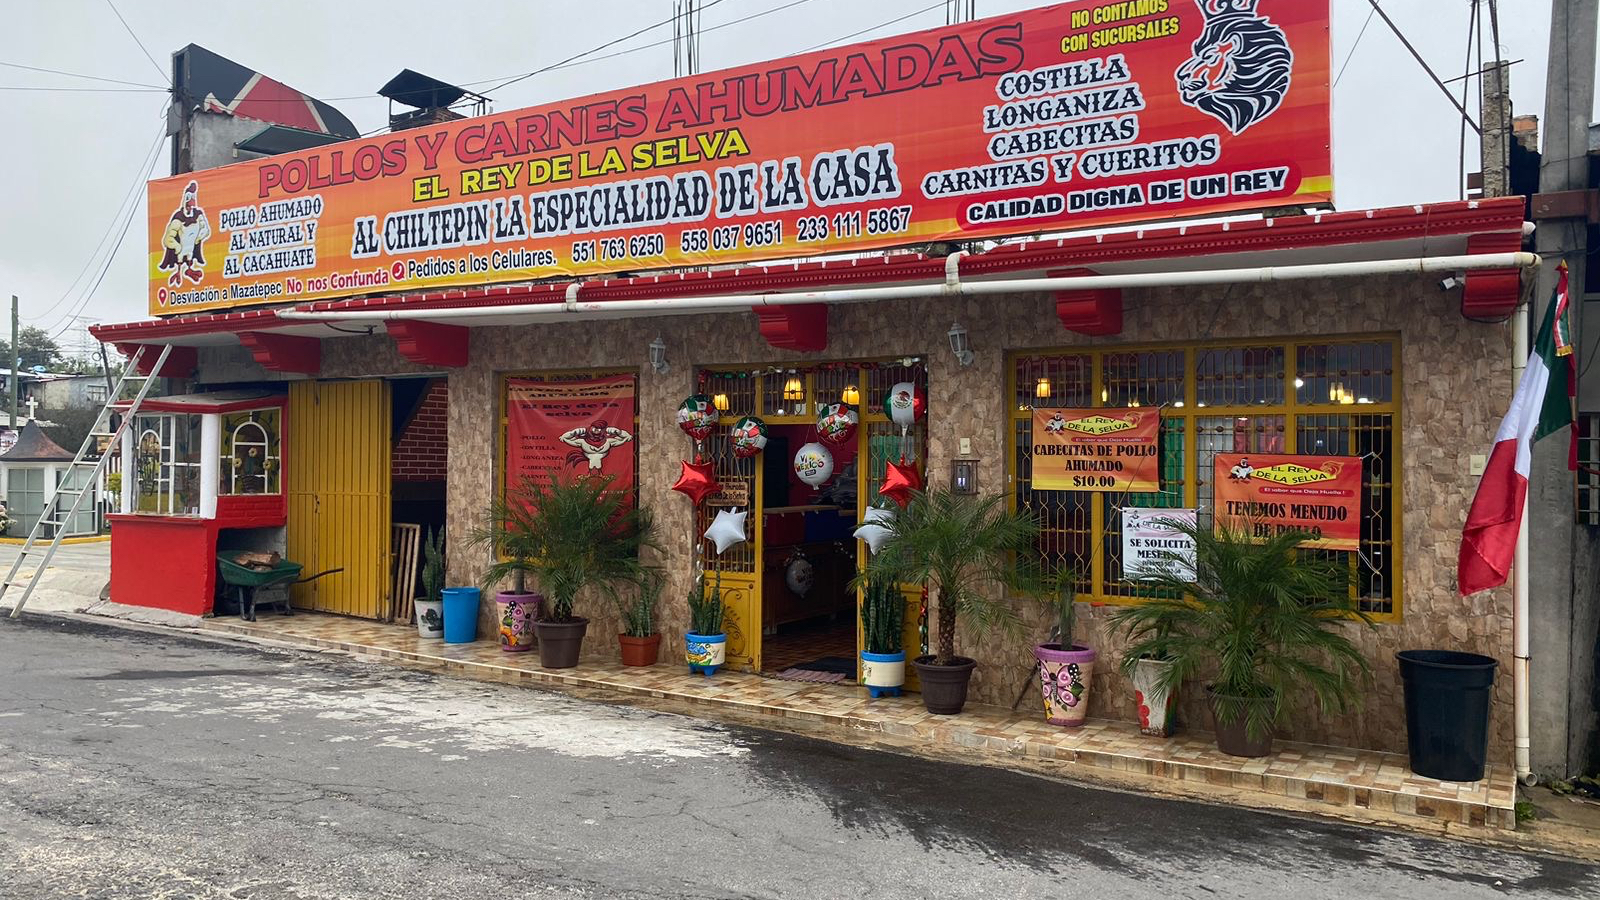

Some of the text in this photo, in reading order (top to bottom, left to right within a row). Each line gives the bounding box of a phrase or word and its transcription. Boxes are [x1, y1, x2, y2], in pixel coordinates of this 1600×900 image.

[1071, 0, 1168, 29] NO CONTAMOS
[1061, 17, 1179, 53] CON SUCURSALES
[1000, 58, 1127, 97] COSTILLA
[258, 21, 1024, 198] POLLOS Y CARNES AHUMADAS
[987, 87, 1142, 130] LONGANIZA
[991, 118, 1135, 158] CABECITAS
[413, 129, 749, 203] EL REY DE LA SELVA
[924, 138, 1216, 196] CARNITAS Y CUERITOS
[353, 148, 897, 255] AL CHILTEPIN LA ESPECIALIDAD DE LA CASA
[969, 168, 1285, 221] CALIDAD DIGNA DE UN REY
[221, 197, 321, 230] POLLO AHUMADO
[798, 207, 911, 241] 233 111 5867
[230, 222, 316, 252] AL NATURAL Y
[573, 233, 664, 263] 551 763 6250
[681, 222, 781, 252] 558 037 9651
[224, 249, 314, 276] AL CACAHUATE
[408, 250, 557, 280] Pedidos a los Celulares.
[170, 269, 388, 306] Desviación a Mazatepec No nos Confunda
[1068, 422, 1130, 433] DE LA SELVA
[1034, 445, 1156, 456] CABECITAS DE POLLO
[1065, 459, 1123, 471] AHUMADO
[1073, 475, 1115, 487] $10.00
[1256, 470, 1327, 483] DE LA SELVA
[1226, 500, 1347, 521] TENEMOS MENUDO
[1130, 539, 1191, 548] SE SOLICITA
[1253, 522, 1271, 538] DE
